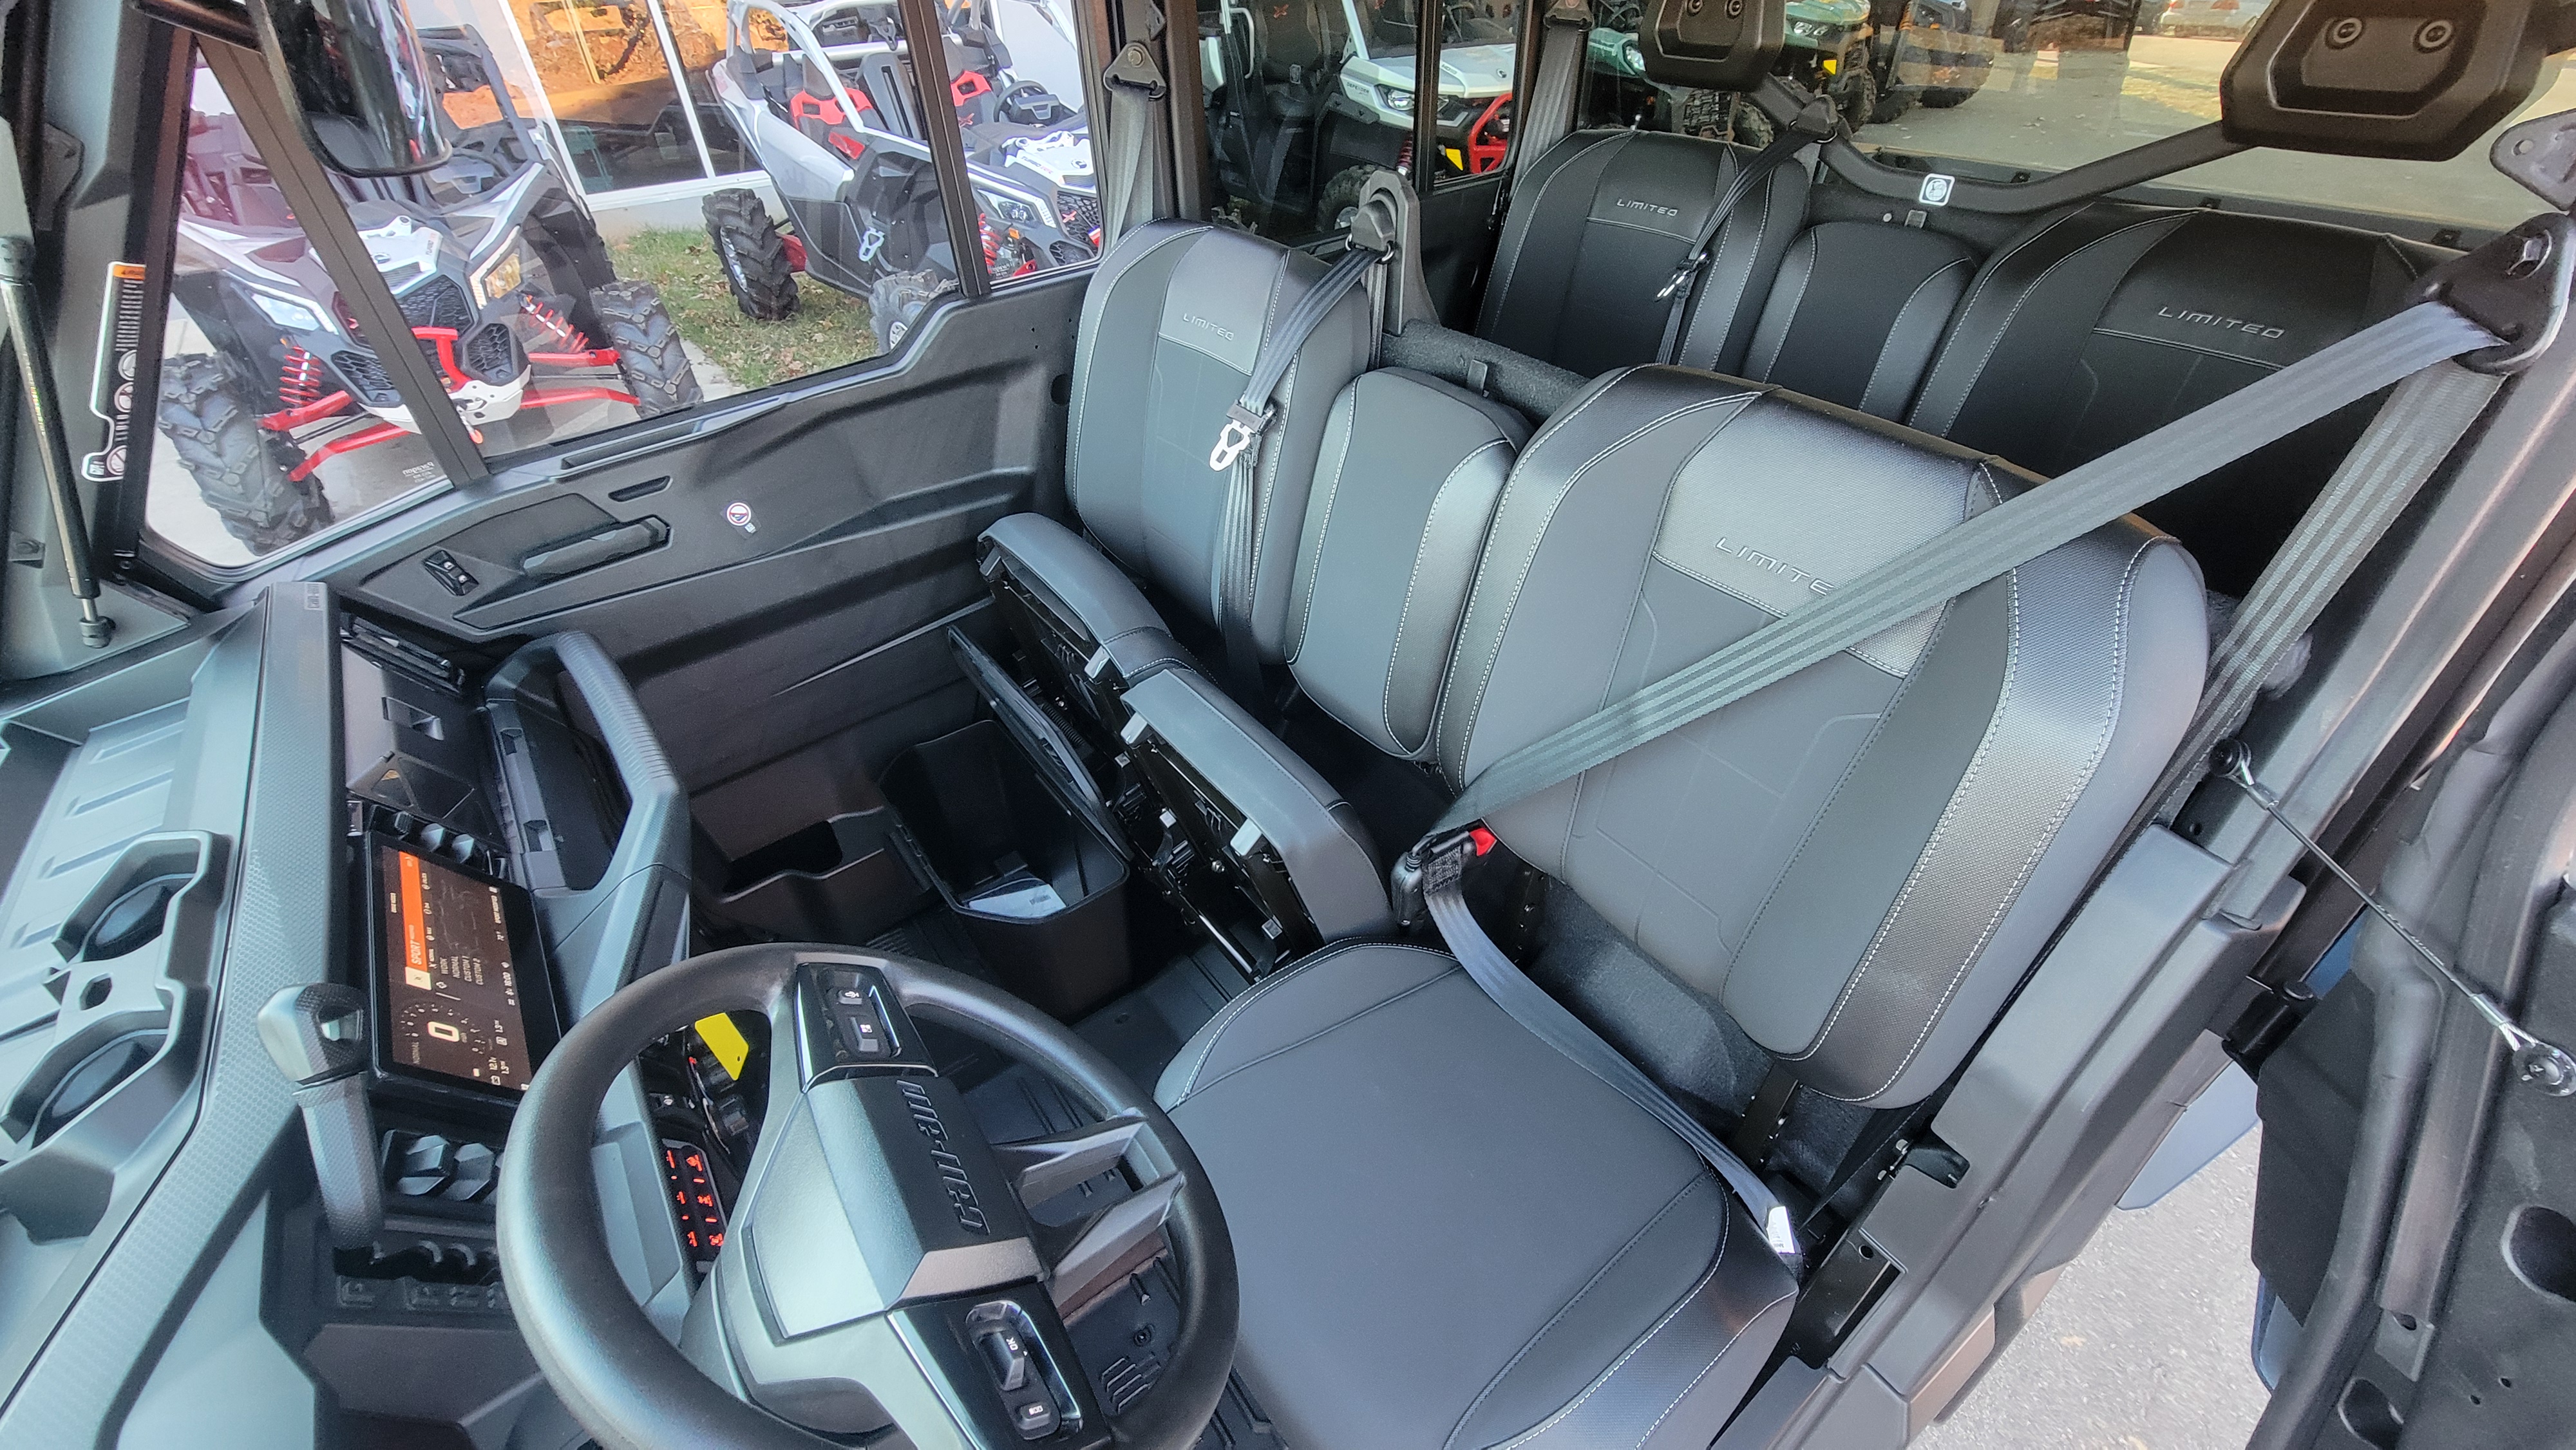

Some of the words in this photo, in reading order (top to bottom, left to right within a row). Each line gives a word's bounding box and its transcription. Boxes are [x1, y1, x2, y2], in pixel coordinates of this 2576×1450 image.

[1616, 198, 1678, 216] LIMITED
[1182, 313, 1235, 341] LIMITED
[2157, 306, 2286, 339] LIMITED
[1715, 537, 1835, 596] LIMITE
[410, 941, 422, 965] SPORT
[439, 957, 449, 974] WORK
[450, 956, 460, 979] NORMAL
[462, 959, 472, 982] CUSTOM
[473, 962, 483, 985] CUSTOM
[427, 1021, 460, 1042] 0
[1006, 1337, 1019, 1351] OK
